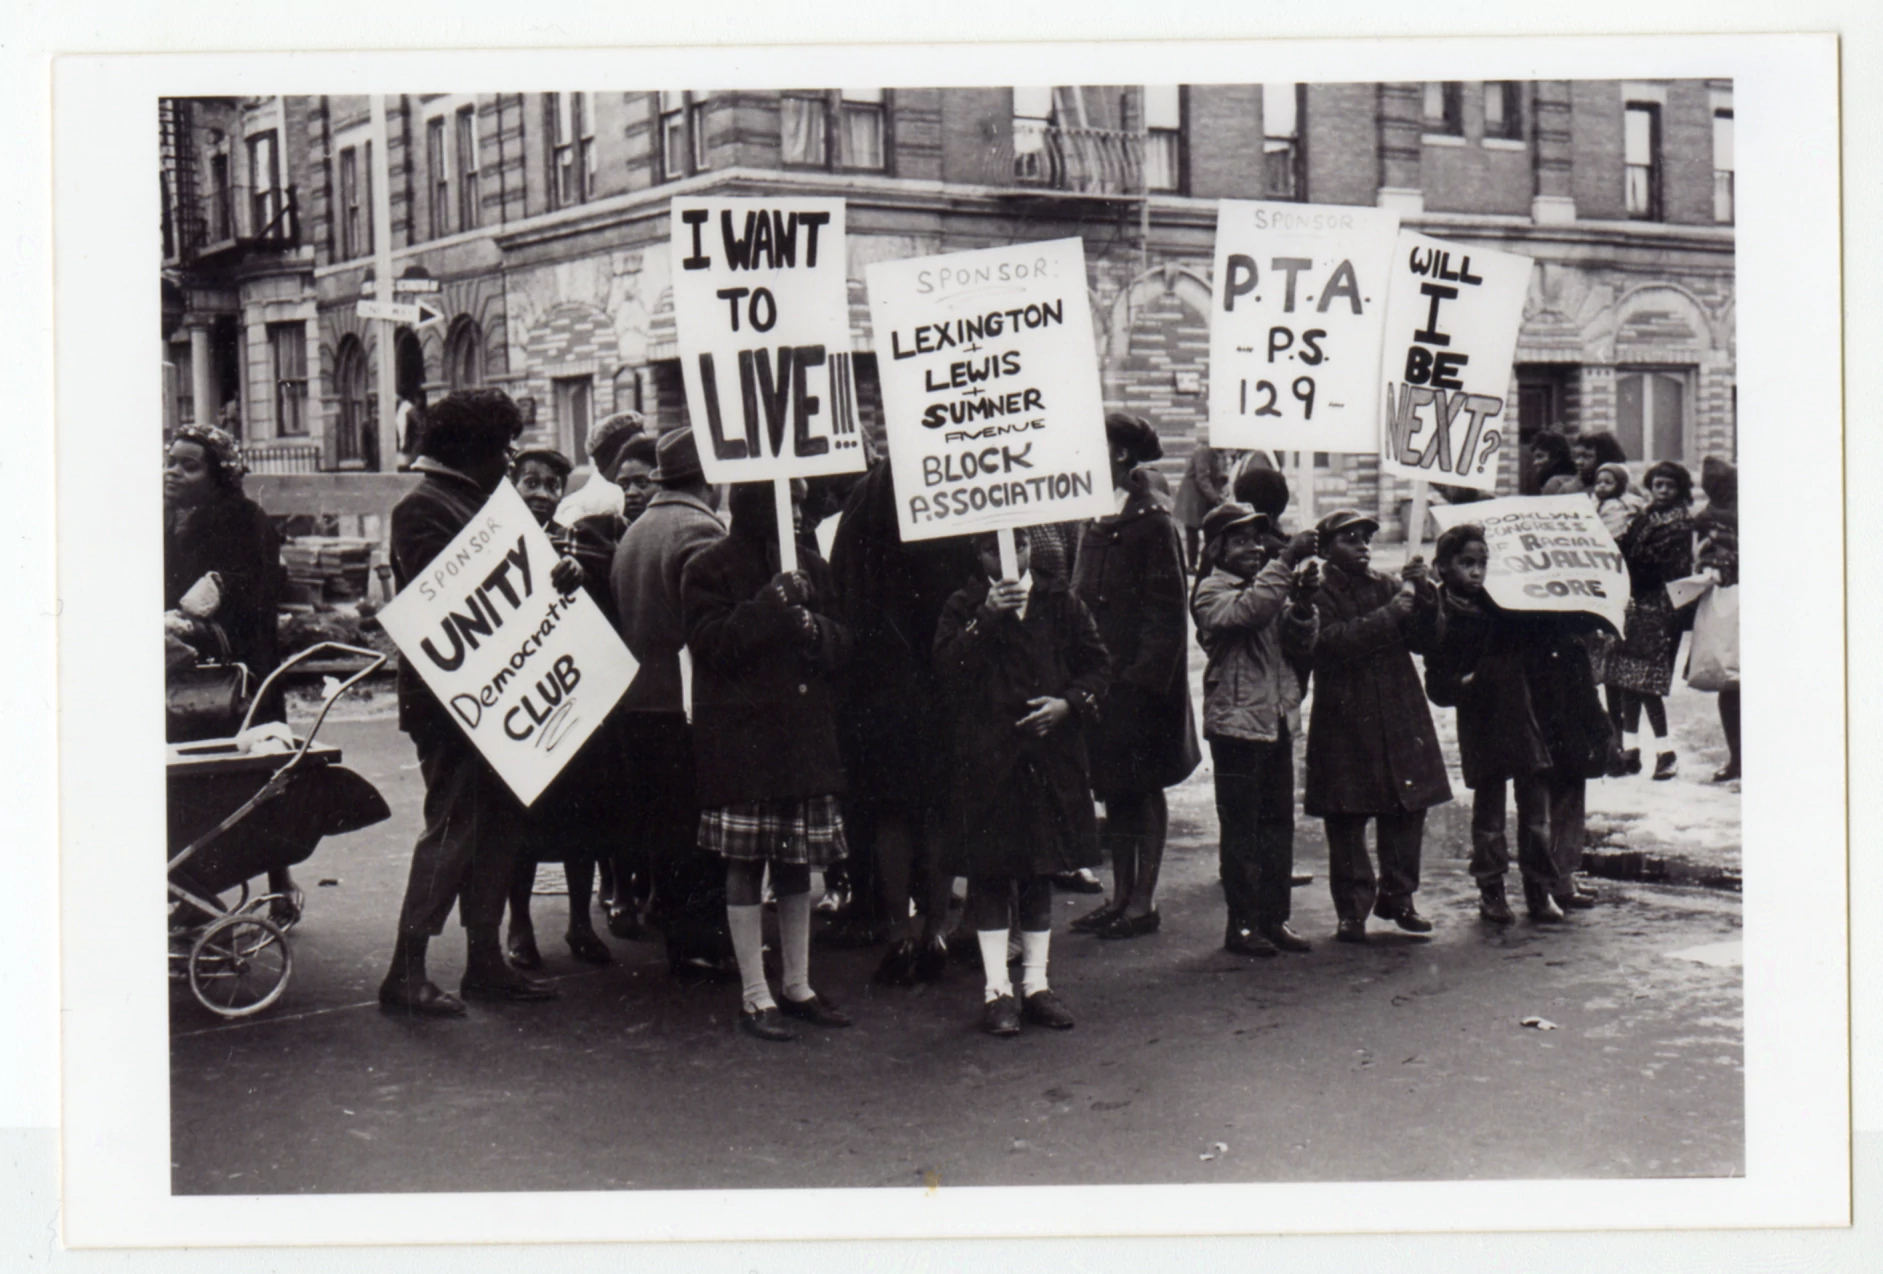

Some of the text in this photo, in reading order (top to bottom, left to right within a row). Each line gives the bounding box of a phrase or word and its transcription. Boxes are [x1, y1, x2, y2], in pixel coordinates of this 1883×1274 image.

[681, 208, 830, 271] I WANT
[1409, 246, 1483, 286] WILL
[716, 286, 777, 333] TO
[1223, 253, 1371, 315] P.T.A.
[891, 298, 1063, 360] LEXINGTON
[1413, 282, 1459, 347] I
[925, 350, 1021, 393] LEWIS
[1404, 346, 1469, 390] BE
[699, 344, 858, 461] LIVE!!!
[921, 387, 1046, 429] SUMNER
[1240, 375, 1316, 421] 129
[945, 418, 1046, 444] AVENUE
[1385, 381, 1503, 476] NEXT?
[922, 442, 1034, 487] BLOCK
[909, 470, 1093, 523] ASSOCIATION
[419, 516, 502, 602] SPONSOR
[419, 533, 533, 672] UNITY
[1522, 579, 1607, 599] CORE
[450, 593, 577, 730] Democratic
[503, 653, 582, 742] CLUB
